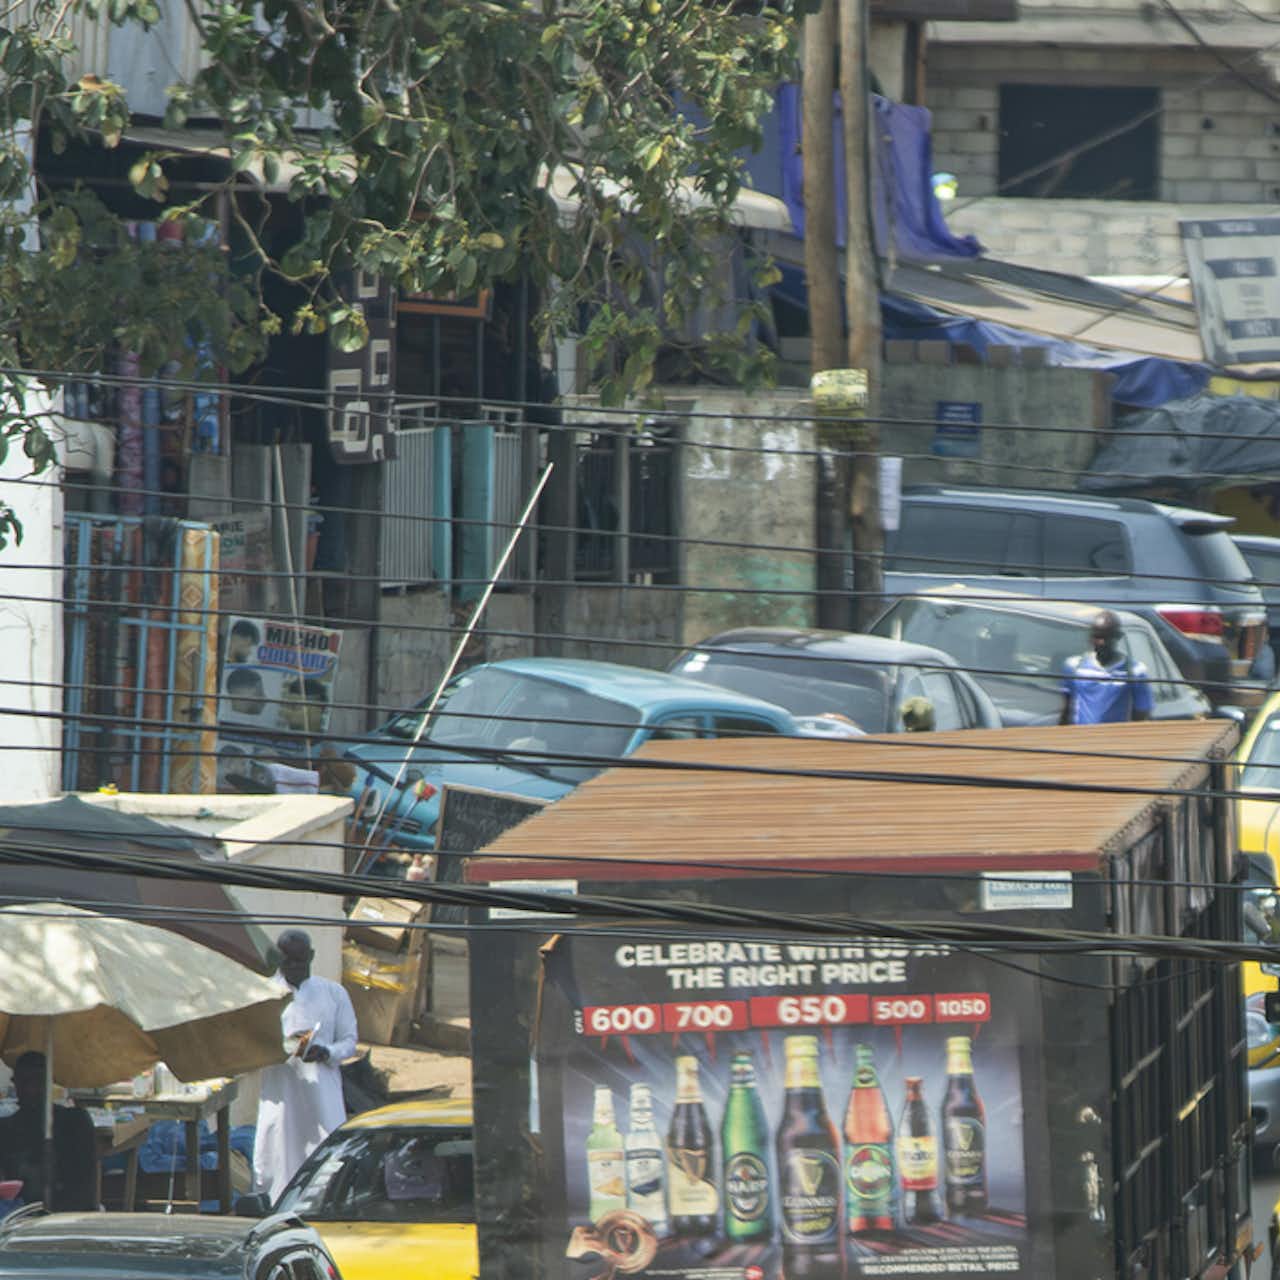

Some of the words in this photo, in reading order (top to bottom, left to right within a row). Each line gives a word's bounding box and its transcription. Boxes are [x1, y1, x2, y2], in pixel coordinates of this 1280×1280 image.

[616, 941, 782, 968] CELEBRATE
[666, 967, 725, 990] THE
[729, 963, 817, 987] RIGHT
[822, 960, 907, 985] PRICE
[591, 1005, 655, 1032] 600
[676, 1004, 734, 1028] 700
[778, 995, 848, 1024] 650
[875, 1000, 927, 1020] 500
[938, 998, 987, 1016] 1050
